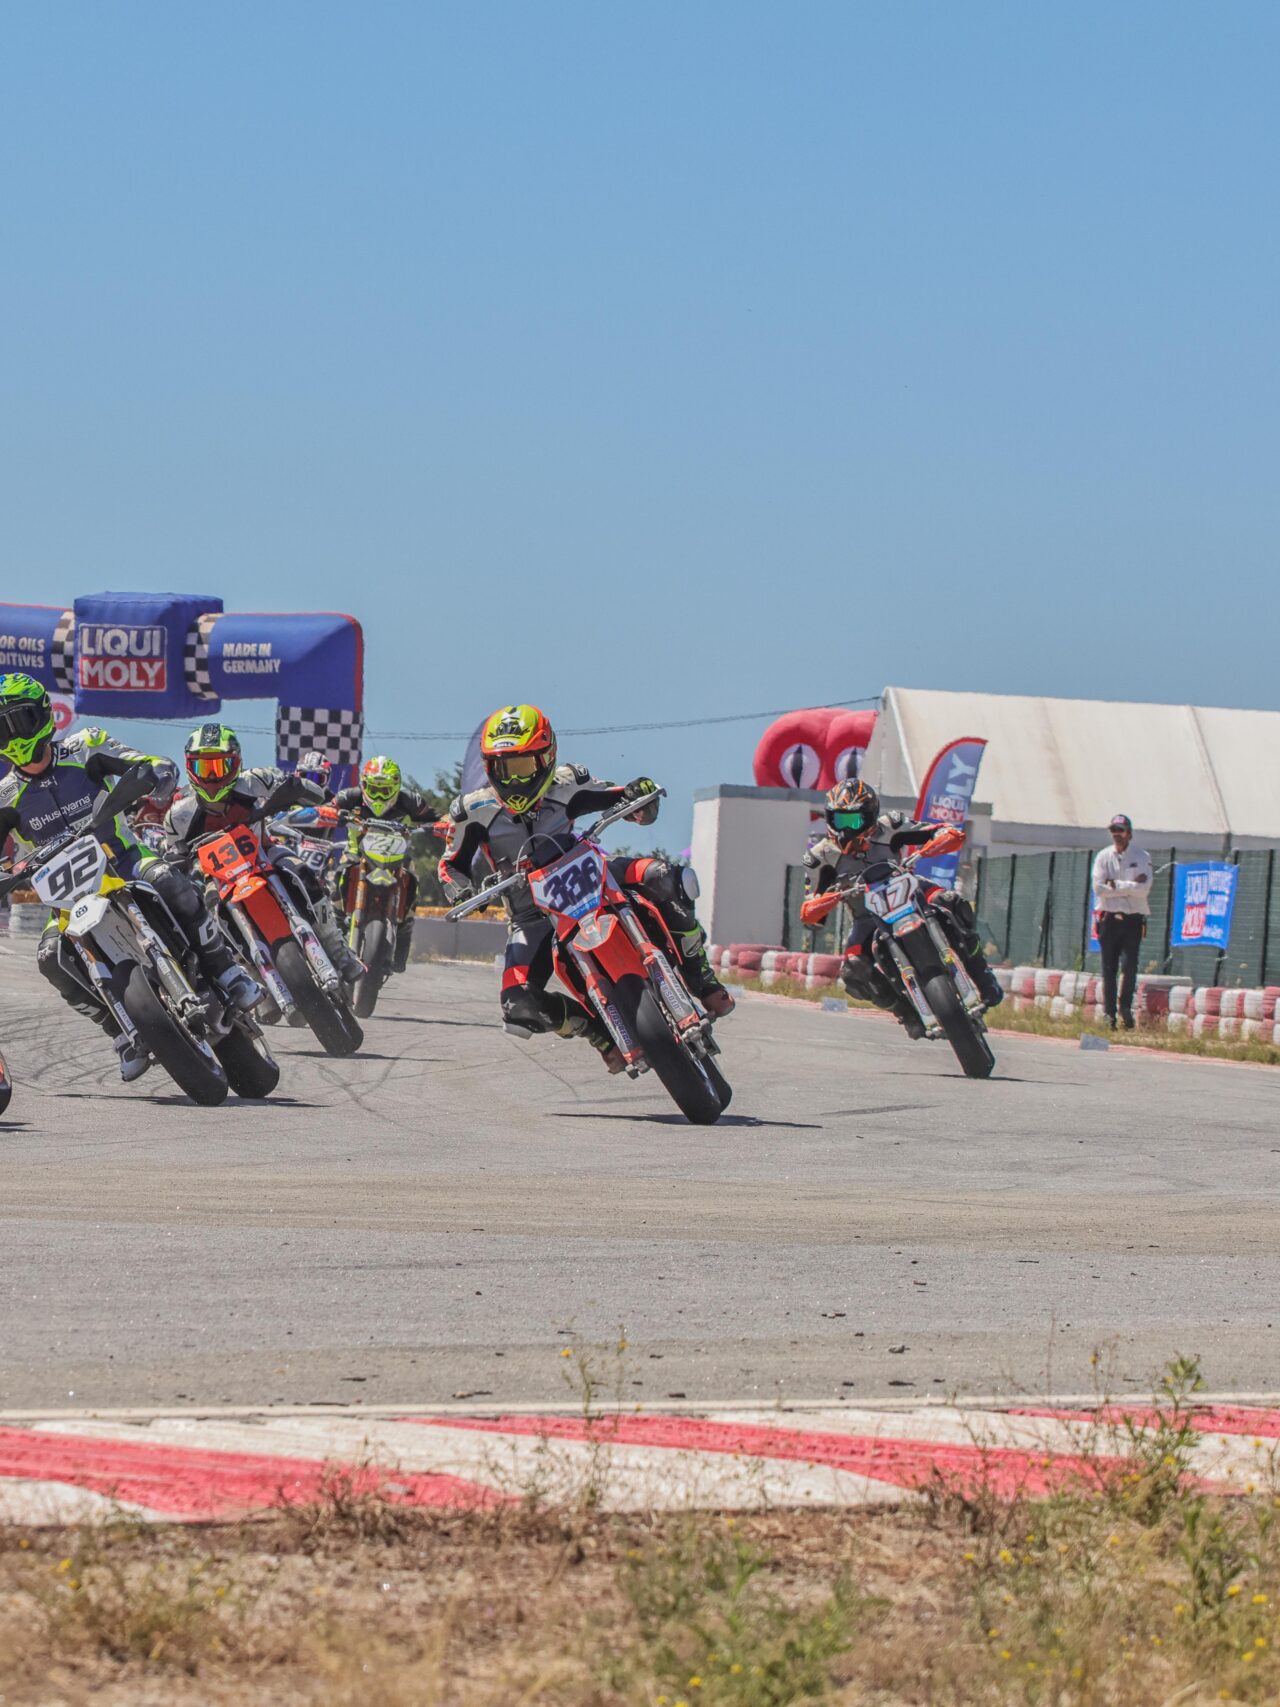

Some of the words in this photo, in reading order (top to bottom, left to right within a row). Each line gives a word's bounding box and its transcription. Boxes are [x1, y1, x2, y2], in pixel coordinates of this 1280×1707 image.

[19, 636, 45, 652] OILS
[81, 628, 161, 657] LIQUI
[223, 642, 256, 658] MADE
[258, 643, 272, 658] IN
[80, 659, 163, 688] MOLY
[223, 659, 281, 674] GERMANY
[42, 795, 91, 825] Husqvarna
[930, 807, 964, 822] MOLY
[932, 795, 964, 811] LIQUI
[207, 835, 256, 872] 136
[48, 846, 100, 901] 92
[871, 877, 912, 918] 17
